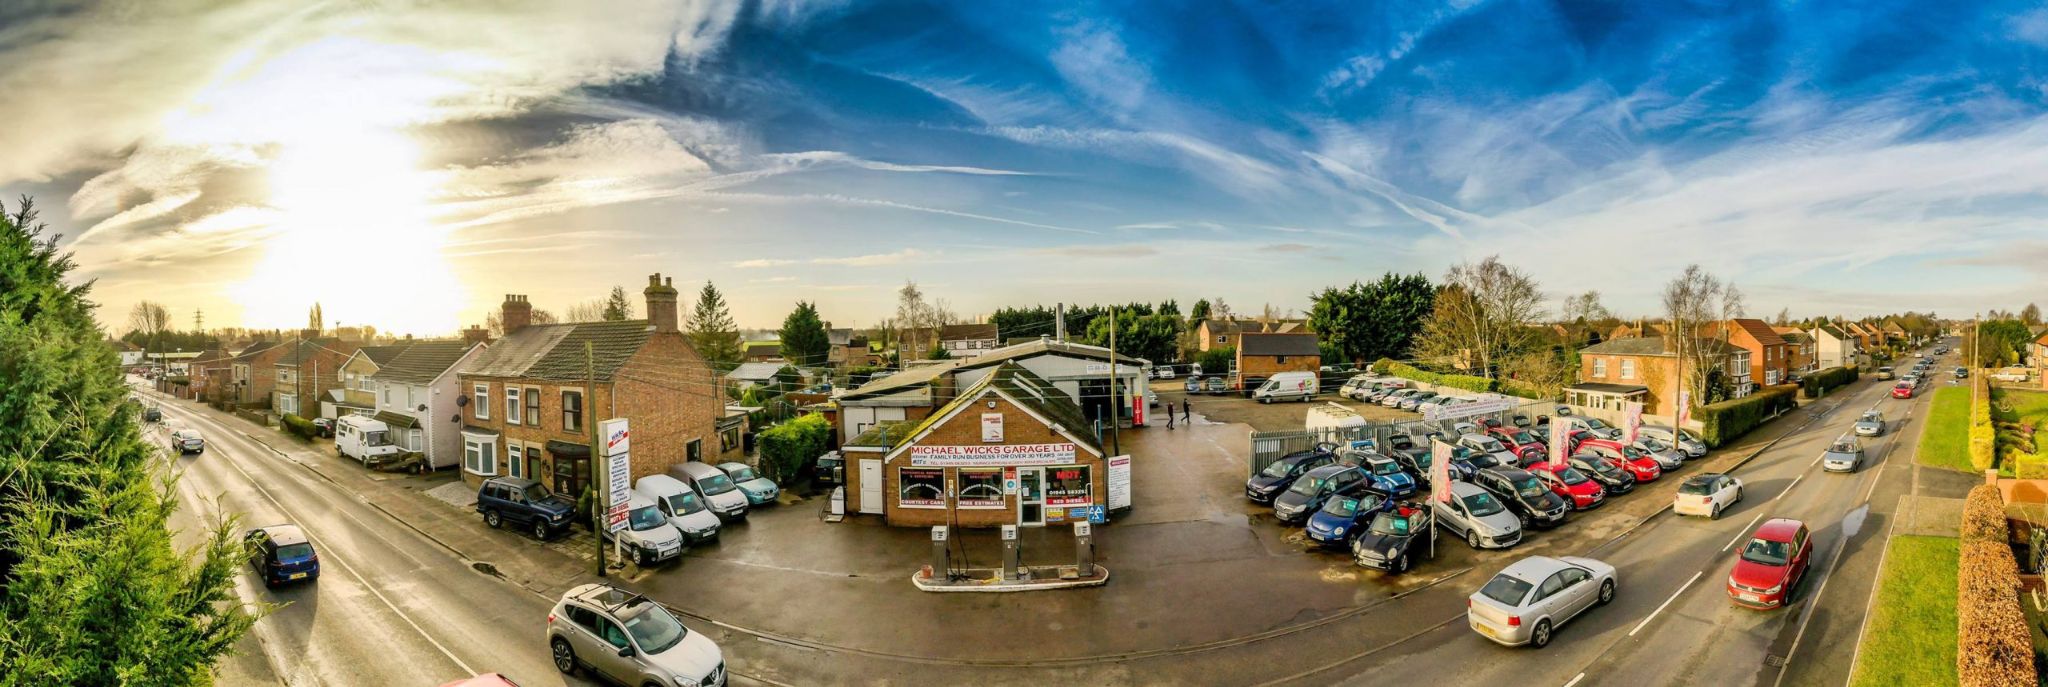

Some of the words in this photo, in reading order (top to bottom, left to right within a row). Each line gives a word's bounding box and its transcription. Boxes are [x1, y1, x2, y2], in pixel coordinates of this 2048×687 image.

[964, 446, 1000, 454] WICKS
[1003, 445, 1050, 454] GARAGE
[1053, 444, 1075, 452] LTD
[1056, 470, 1080, 479] MOT
